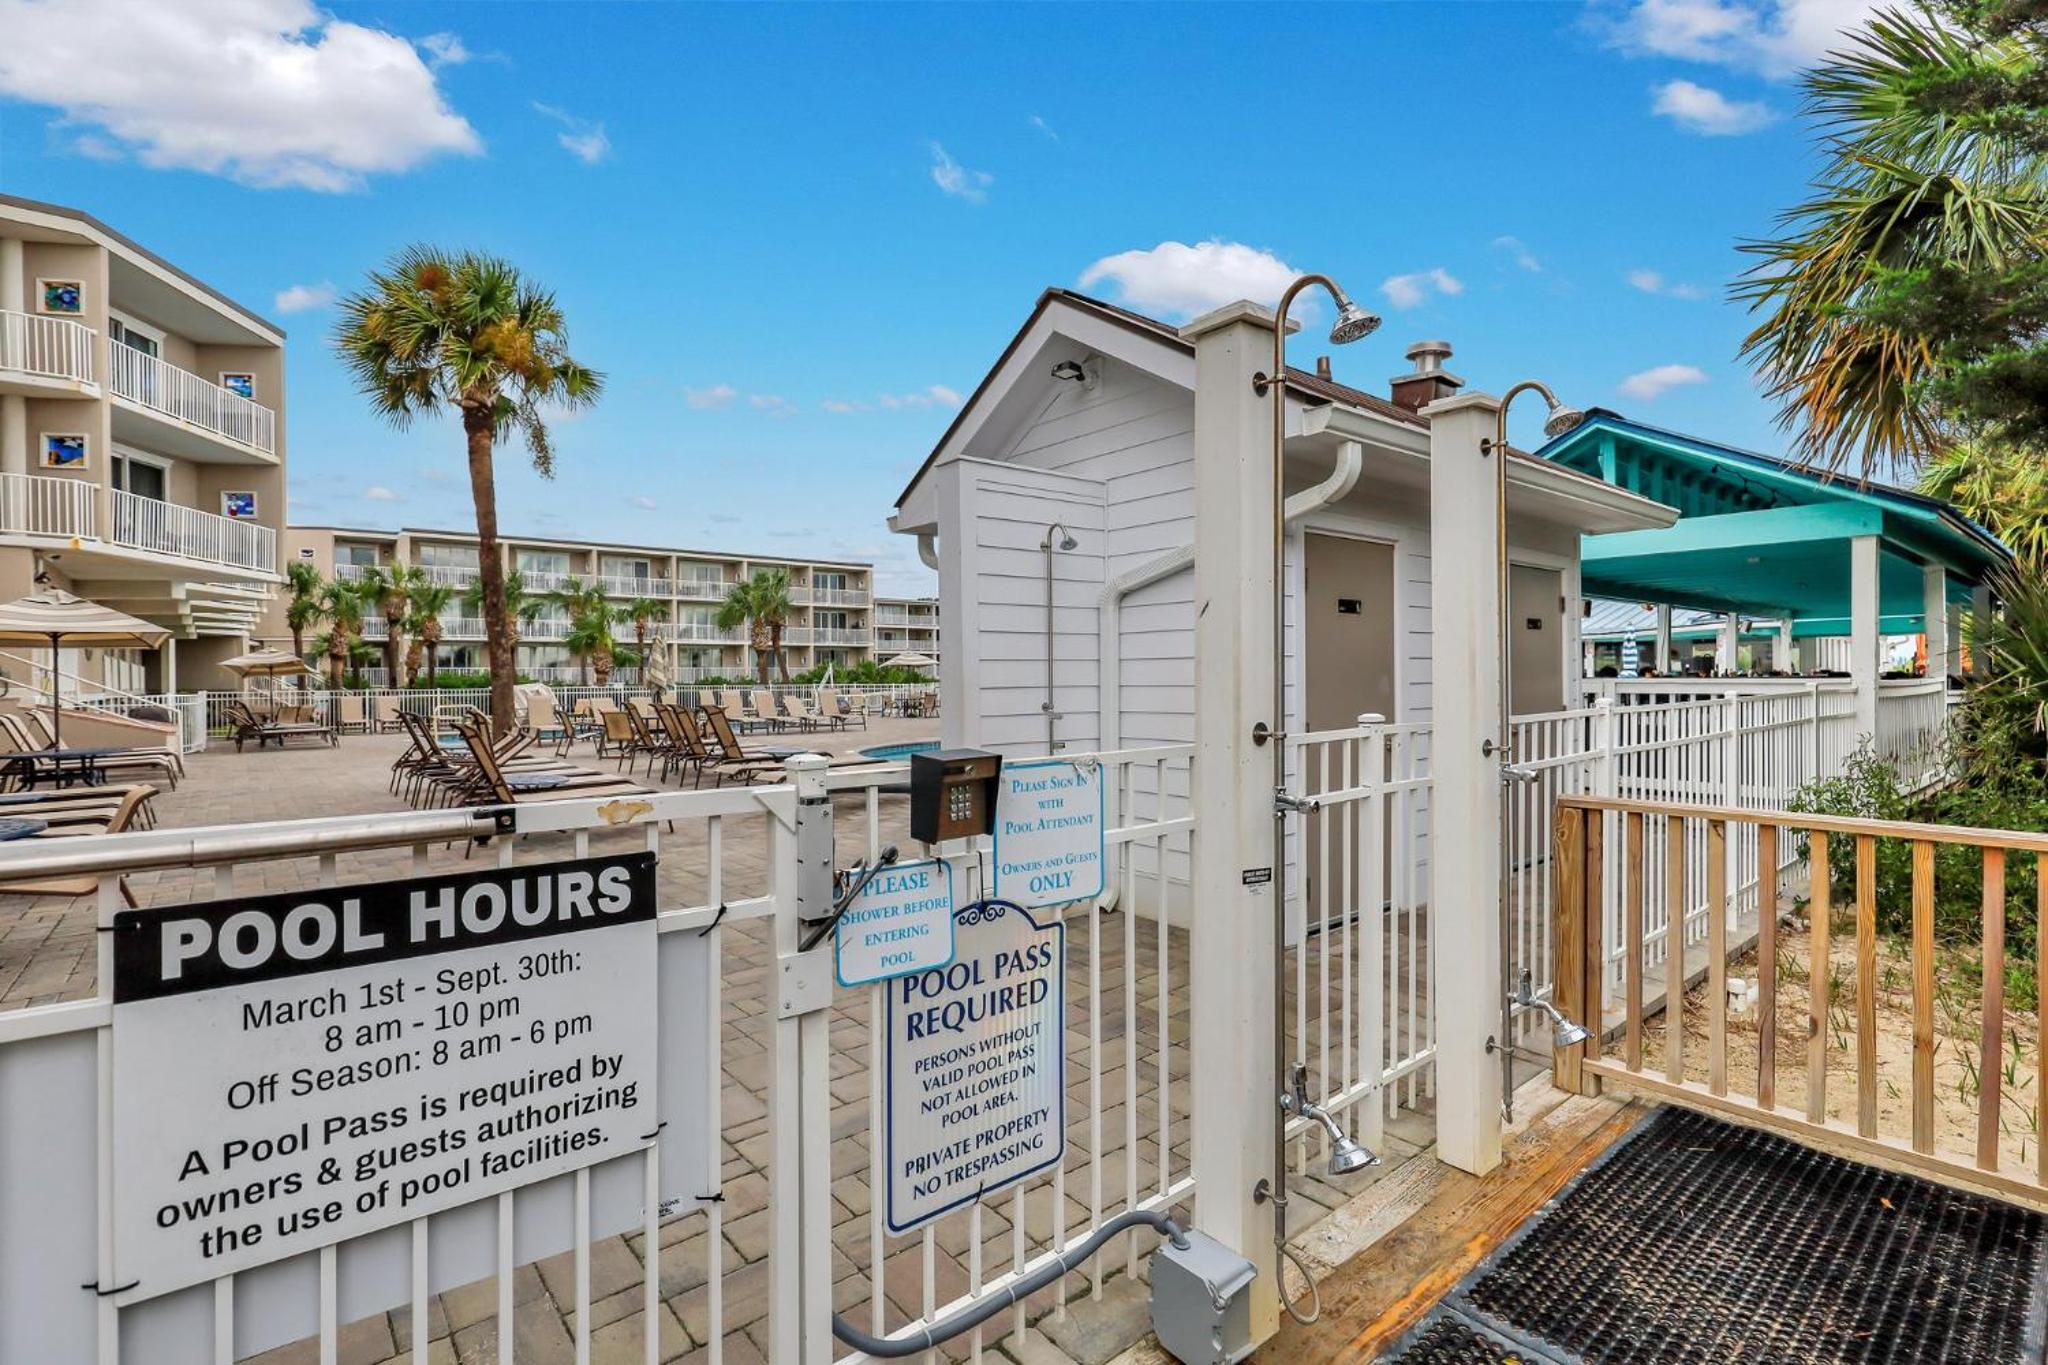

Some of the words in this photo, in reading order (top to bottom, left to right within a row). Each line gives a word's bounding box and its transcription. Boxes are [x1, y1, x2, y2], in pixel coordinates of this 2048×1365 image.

[840, 906, 899, 926] SHOWER
[904, 896, 949, 914] BEFORE
[863, 872, 929, 897] PLEASE
[161, 898, 385, 981] POOL
[410, 866, 632, 943] HOURS
[865, 924, 929, 946] ENTERING
[243, 988, 346, 1031] March
[360, 978, 404, 1010] 1st
[436, 962, 507, 994] Sept.
[518, 949, 581, 980] 30th:
[881, 951, 916, 967] POOL
[903, 959, 984, 1004] POOL
[995, 942, 1052, 979] PASS
[325, 1025, 343, 1052] 8
[355, 1018, 401, 1047] am
[434, 1001, 469, 1031] 10
[480, 996, 520, 1027] pm
[907, 978, 1048, 1041] REQUIRED
[227, 1073, 279, 1110] Off
[291, 1050, 420, 1096] Season:
[432, 1040, 449, 1066] 8
[460, 1033, 501, 1060] am
[530, 1020, 545, 1044] 6
[555, 1014, 592, 1045] pm
[915, 1043, 976, 1074] PERSONS
[979, 1021, 1042, 1053] WITHOUT
[922, 1068, 964, 1092] VALID
[968, 1055, 1004, 1077] POOL
[1008, 1044, 1035, 1063] PASS
[178, 1150, 210, 1182] A
[223, 1122, 309, 1170] Pool
[323, 1106, 408, 1145] Pass
[420, 1095, 447, 1121] is
[459, 1058, 582, 1112] required
[592, 1054, 623, 1079] by
[920, 1092, 952, 1114] NOT
[955, 1069, 1019, 1102] ALLOWED
[1022, 1062, 1036, 1078] IN
[941, 1105, 980, 1128] POOL
[983, 1091, 1019, 1113] AREA.
[156, 1172, 302, 1229] owners
[317, 1157, 342, 1185] &
[354, 1129, 466, 1182] guests
[477, 1081, 638, 1142] authorizing
[905, 1138, 970, 1178] PRIVATE
[976, 1107, 1049, 1149] PROPERTY
[913, 1175, 941, 1200] NO
[944, 1133, 1044, 1186] TRESPASSING
[200, 1222, 263, 1259] the
[278, 1200, 343, 1237] use
[356, 1180, 389, 1213] of
[401, 1158, 470, 1207] pool
[480, 1127, 609, 1178] facilities.
